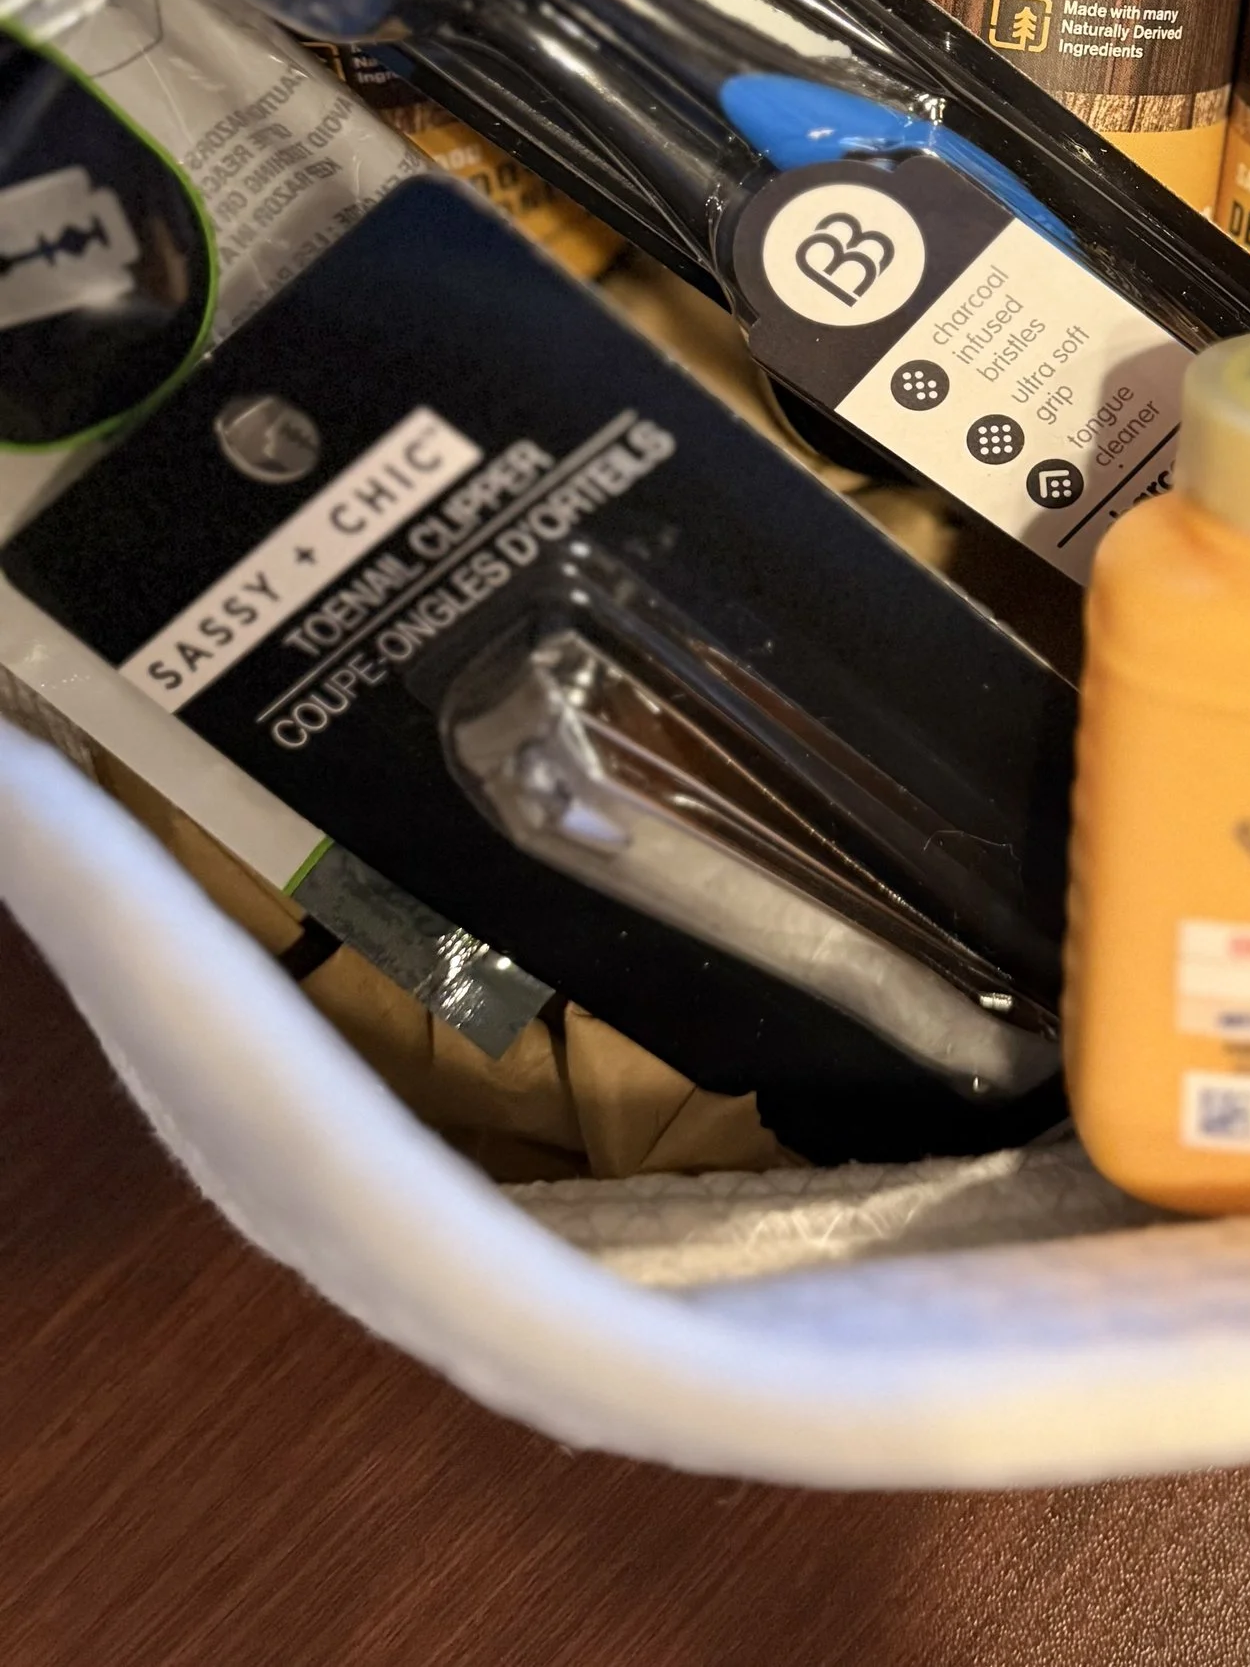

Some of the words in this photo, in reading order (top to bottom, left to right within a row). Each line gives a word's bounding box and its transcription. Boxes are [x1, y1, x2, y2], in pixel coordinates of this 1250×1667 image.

[1061, 19, 1130, 42] Naturally
[1133, 24, 1183, 40] Derived
[1063, 0, 1107, 18] Made
[1110, 5, 1141, 20] with
[1142, 8, 1179, 24] many
[1058, 38, 1144, 58] Ingredients
[932, 265, 1010, 347] charcoal
[951, 294, 1025, 365] infused
[976, 317, 1047, 383] bristles
[1010, 361, 1056, 404] ultra
[1052, 325, 1091, 364] soft
[1036, 384, 1076, 425] grip
[1067, 385, 1136, 450] tongue
[1095, 399, 1162, 468] cleaner
[283, 554, 426, 660] TOENAIL
[409, 439, 557, 562] CLIPPER
[271, 550, 512, 751] COUPE-ONGLES
[495, 418, 678, 567] D'ORTEILS
[148, 570, 282, 692] SASSY
